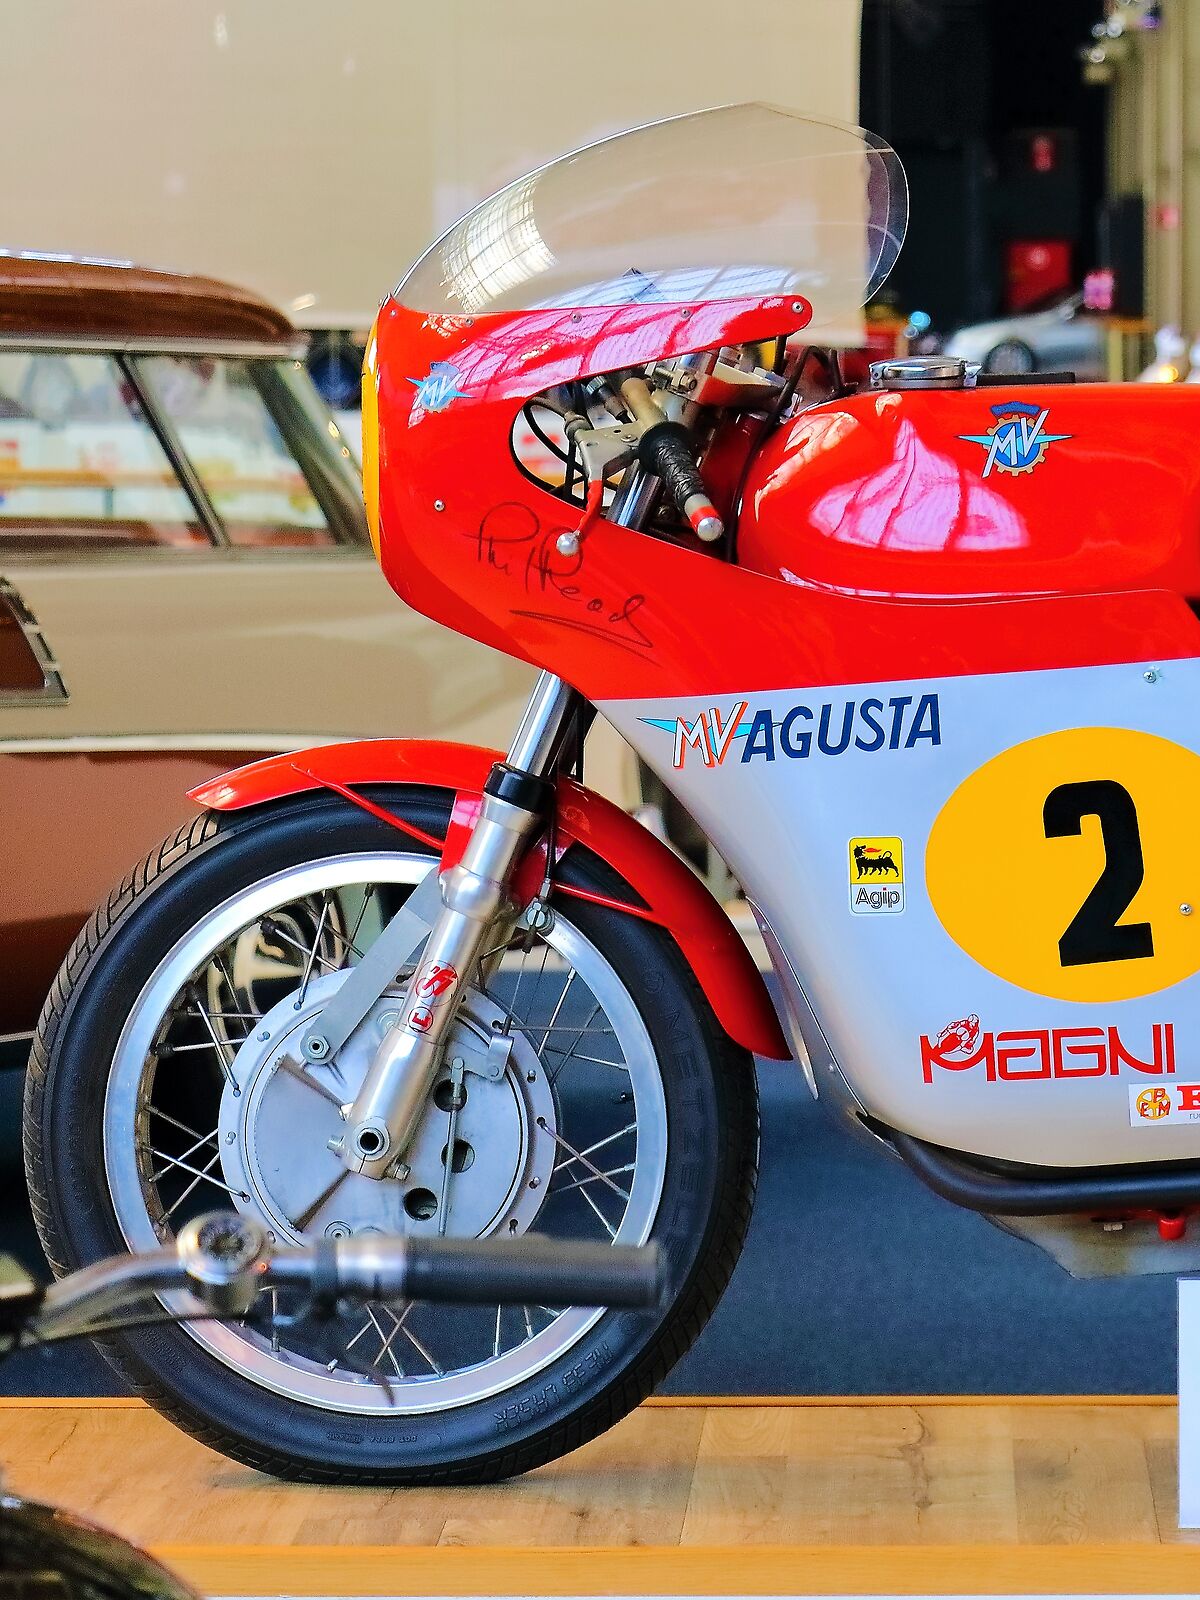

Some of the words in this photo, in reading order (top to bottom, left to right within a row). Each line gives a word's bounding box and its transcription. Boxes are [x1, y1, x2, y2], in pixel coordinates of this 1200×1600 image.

[411, 373, 464, 410] MV
[981, 408, 1050, 479] MV
[673, 701, 749, 769] MV
[741, 692, 942, 763] AGUSTA
[855, 886, 901, 910] Agip
[1042, 779, 1155, 967] 2
